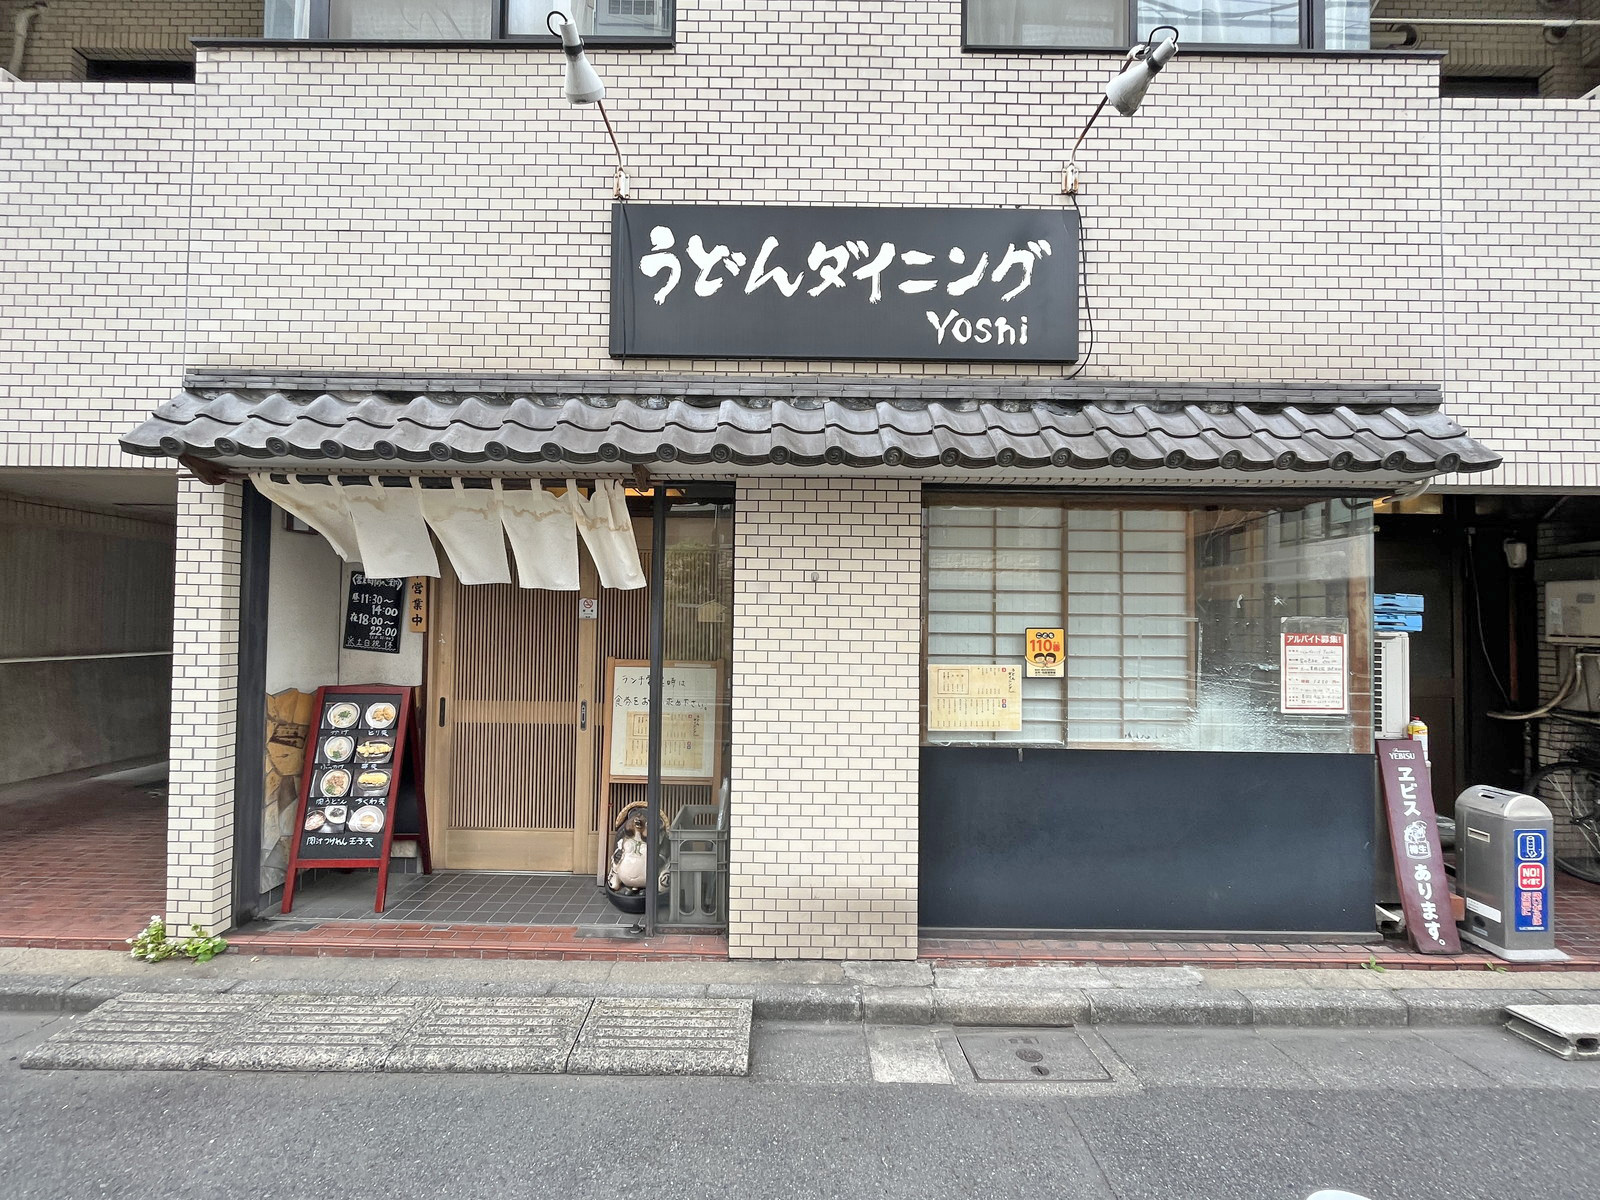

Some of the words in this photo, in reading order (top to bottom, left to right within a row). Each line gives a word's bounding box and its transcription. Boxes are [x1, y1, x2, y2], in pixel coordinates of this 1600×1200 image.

[639, 225, 1052, 304] うどんダイニング
[926, 309, 1028, 345] Yoshi
[371, 604, 398, 616] 14:00
[411, 582, 424, 627] 営業中
[369, 626, 397, 637] 22:00
[1029, 639, 1061, 652] 110番
[1388, 752, 1415, 760] YEBISU
[1522, 868, 1540, 877] NO!
[1414, 864, 1446, 946] あります。
